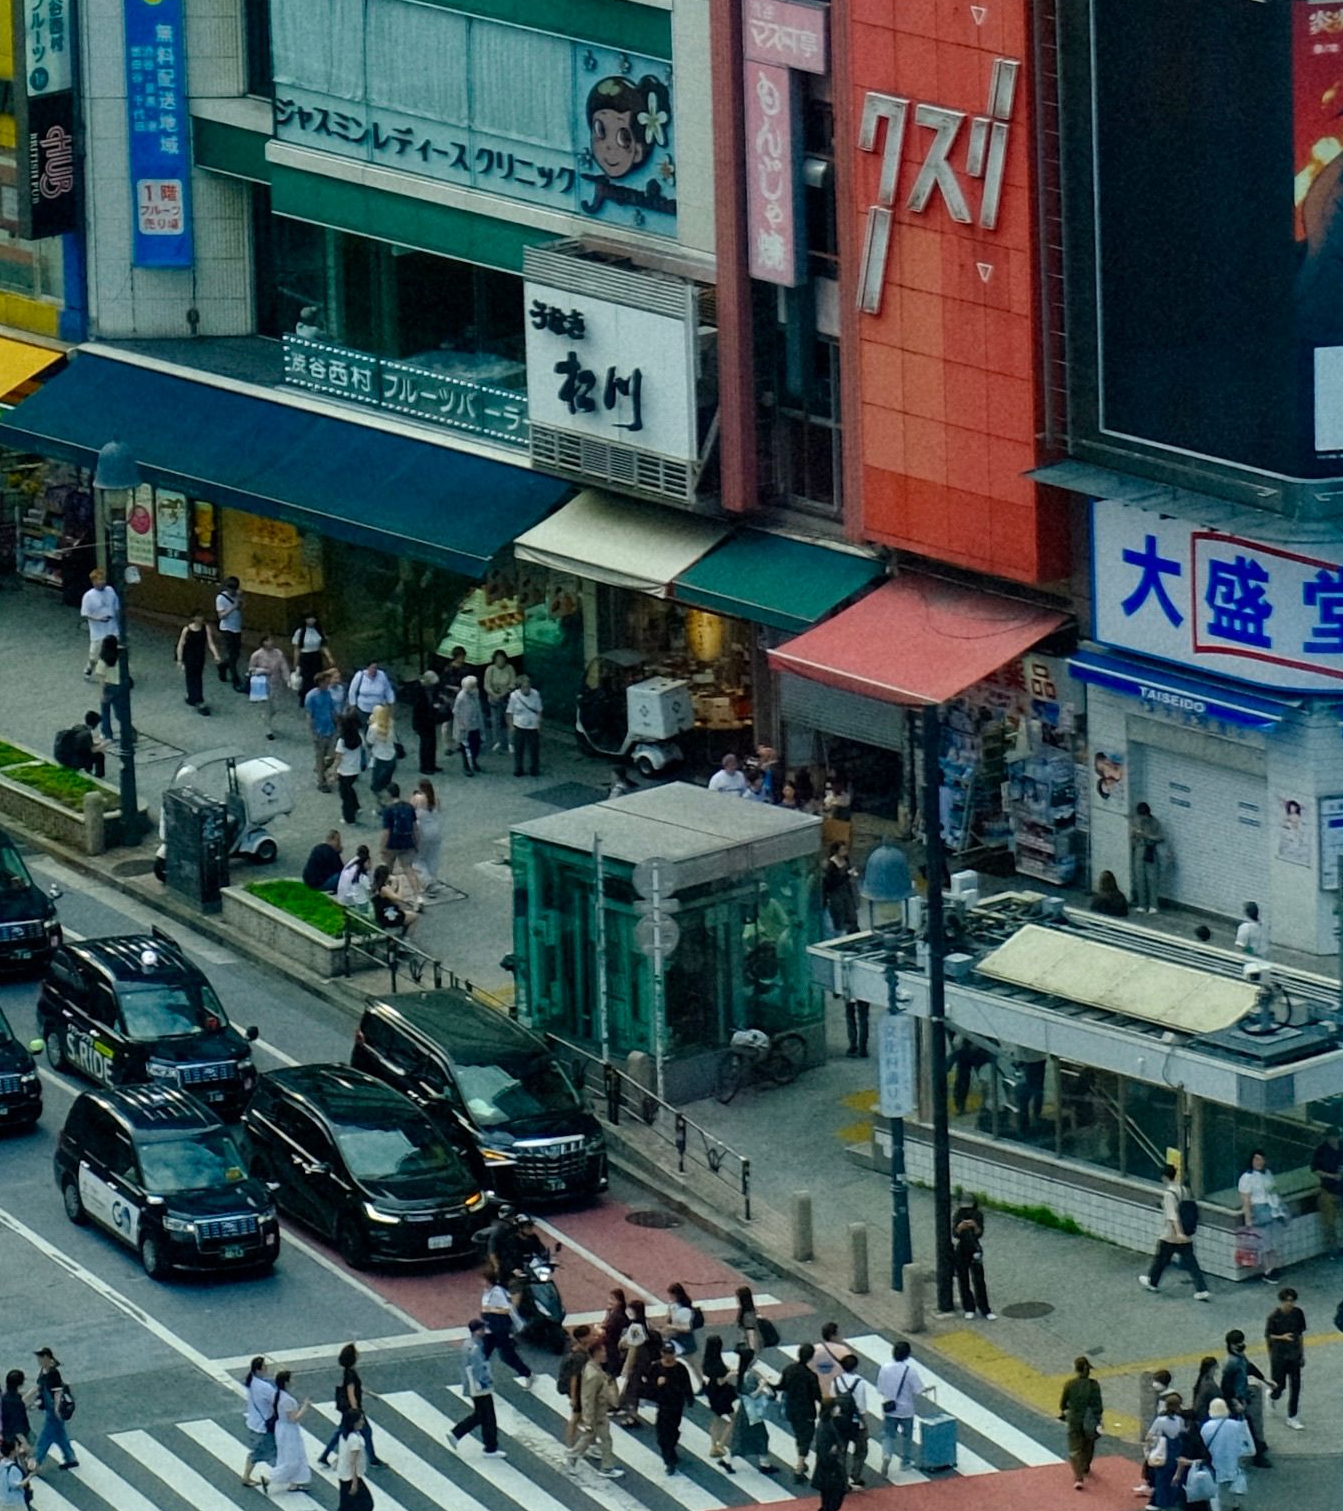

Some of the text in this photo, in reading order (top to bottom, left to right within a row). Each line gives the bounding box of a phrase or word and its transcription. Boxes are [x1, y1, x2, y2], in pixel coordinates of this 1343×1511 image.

[155, 24, 179, 155] 無料配送地域
[39, 125, 74, 199] HUB
[756, 70, 786, 272] もんじゃ焼
[858, 56, 1019, 316] クスリ
[140, 205, 181, 217] フルーツ
[144, 184, 177, 202] 1階
[290, 353, 372, 393] 渋谷西村
[1138, 685, 1207, 714] TAISEIDO
